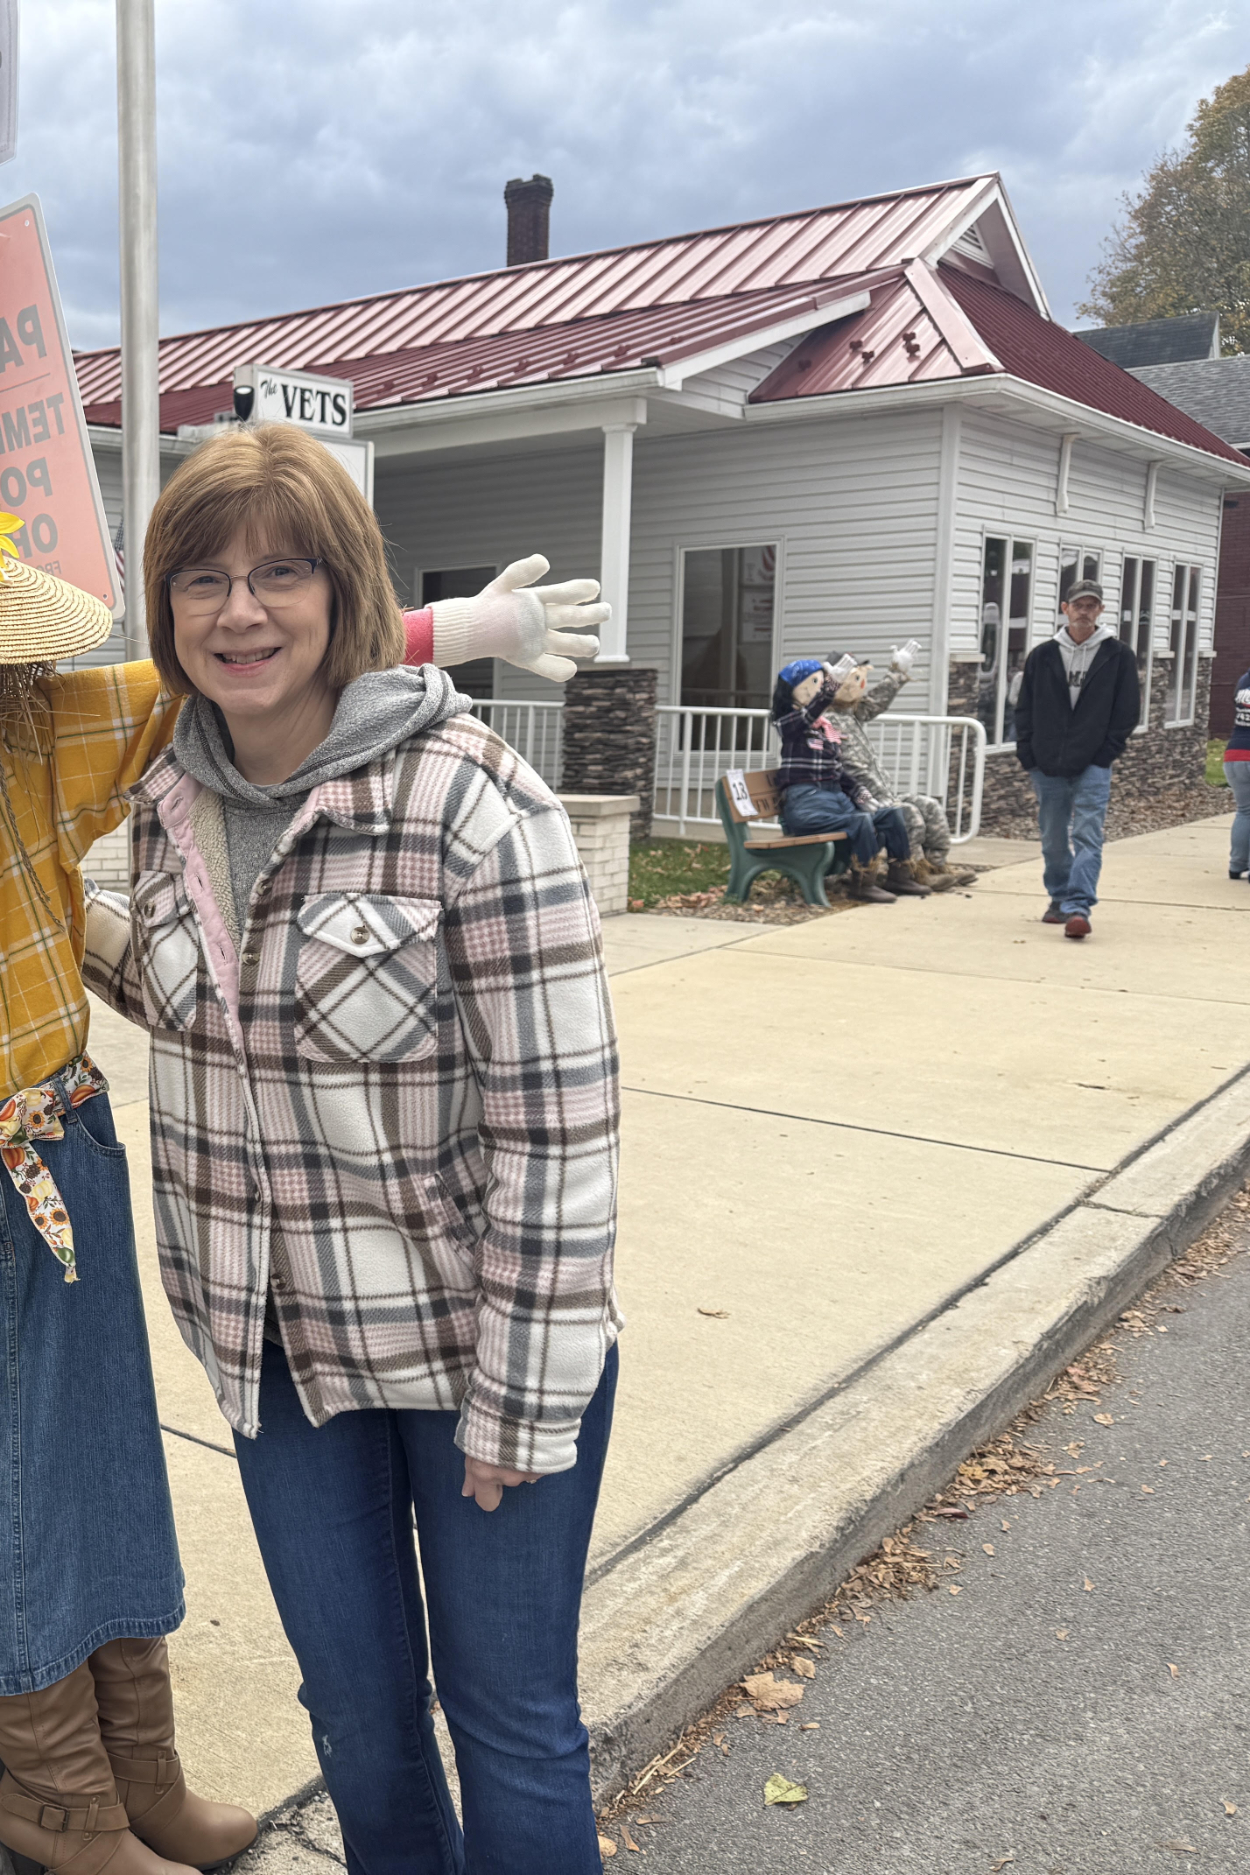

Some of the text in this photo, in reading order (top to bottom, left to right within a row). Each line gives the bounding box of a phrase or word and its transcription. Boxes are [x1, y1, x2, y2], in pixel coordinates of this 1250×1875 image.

[260, 378, 347, 427] The VETS
[732, 781, 748, 800] 13
